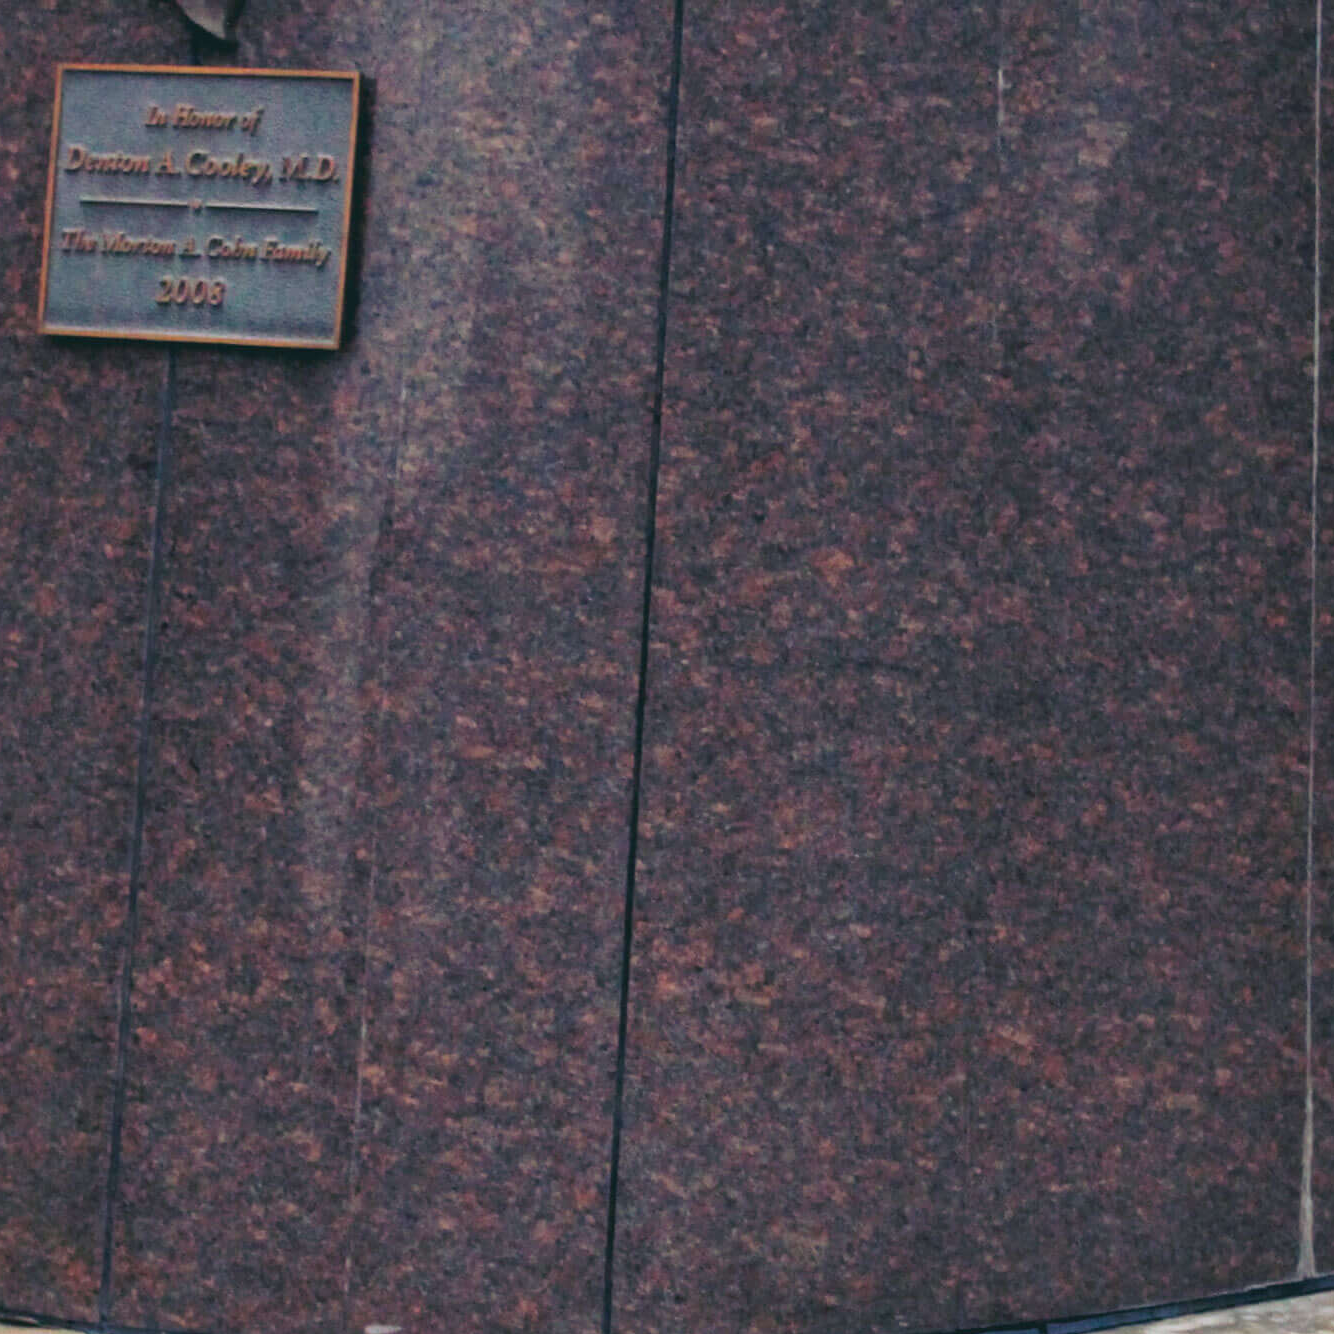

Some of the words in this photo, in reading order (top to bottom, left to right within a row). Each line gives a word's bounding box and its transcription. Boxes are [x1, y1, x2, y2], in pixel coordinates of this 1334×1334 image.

[144, 105, 167, 128] In
[172, 103, 237, 130] Honor
[239, 107, 265, 136] of
[65, 145, 151, 175] Denton
[185, 150, 273, 184] Cooley,
[278, 154, 340, 184] M.D.
[61, 227, 98, 254] The
[260, 236, 332, 268] Family
[156, 275, 227, 307] 2008
